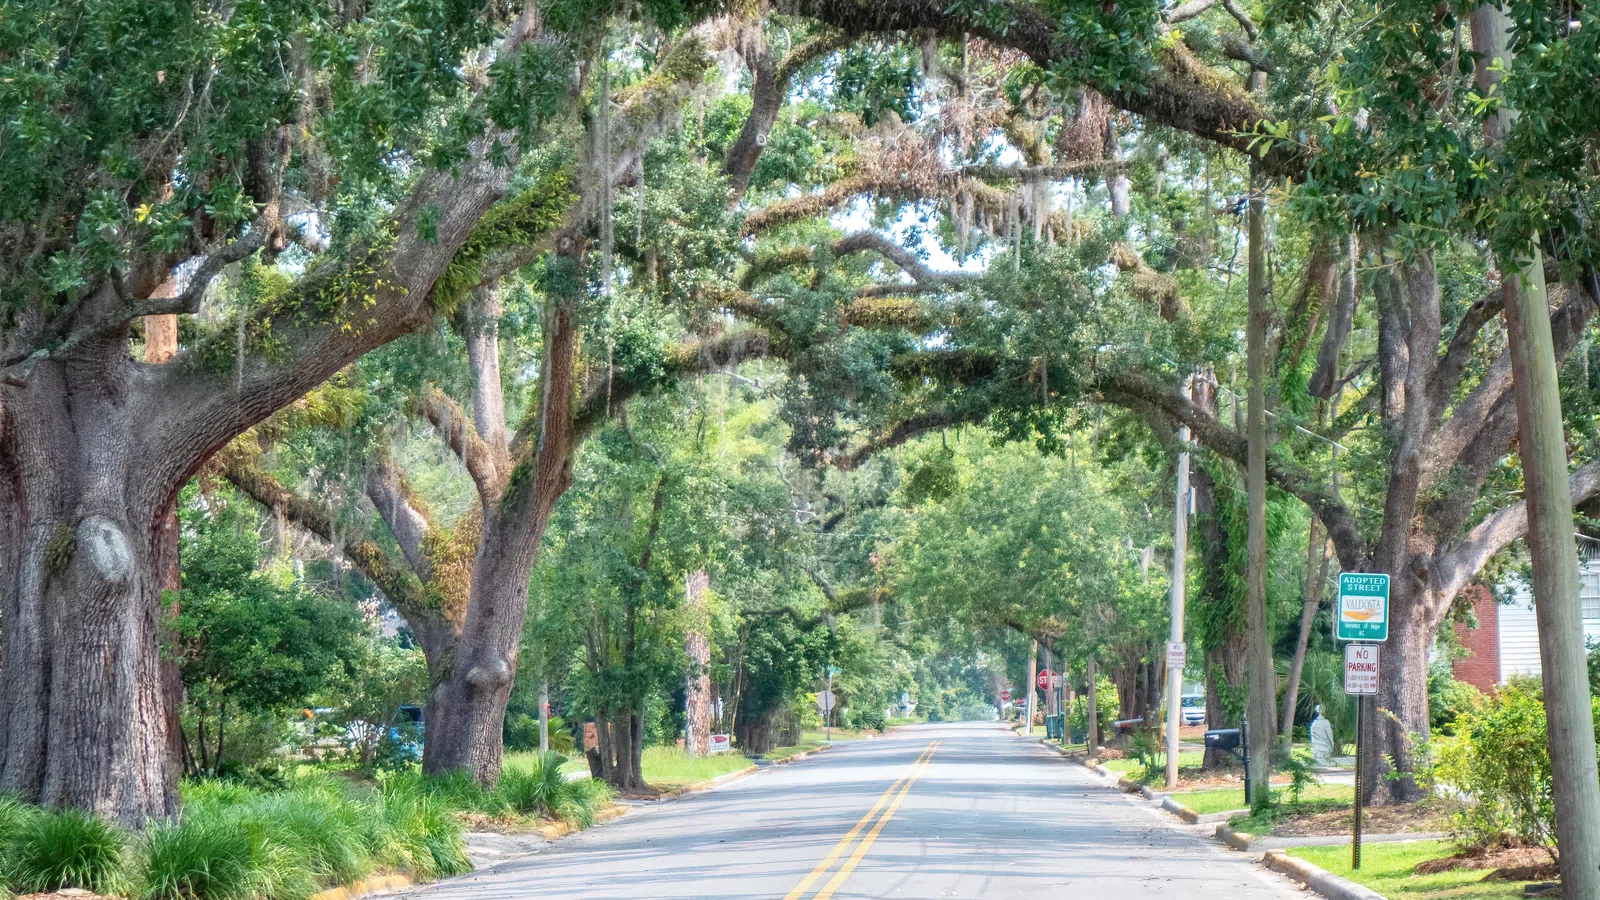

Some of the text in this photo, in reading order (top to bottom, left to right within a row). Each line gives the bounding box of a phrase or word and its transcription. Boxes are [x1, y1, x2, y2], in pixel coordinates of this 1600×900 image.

[1344, 576, 1386, 584] ADOPTED
[1346, 599, 1380, 610] VALDOSTA
[1356, 650, 1368, 659] NO
[1348, 662, 1376, 672] PARKING
